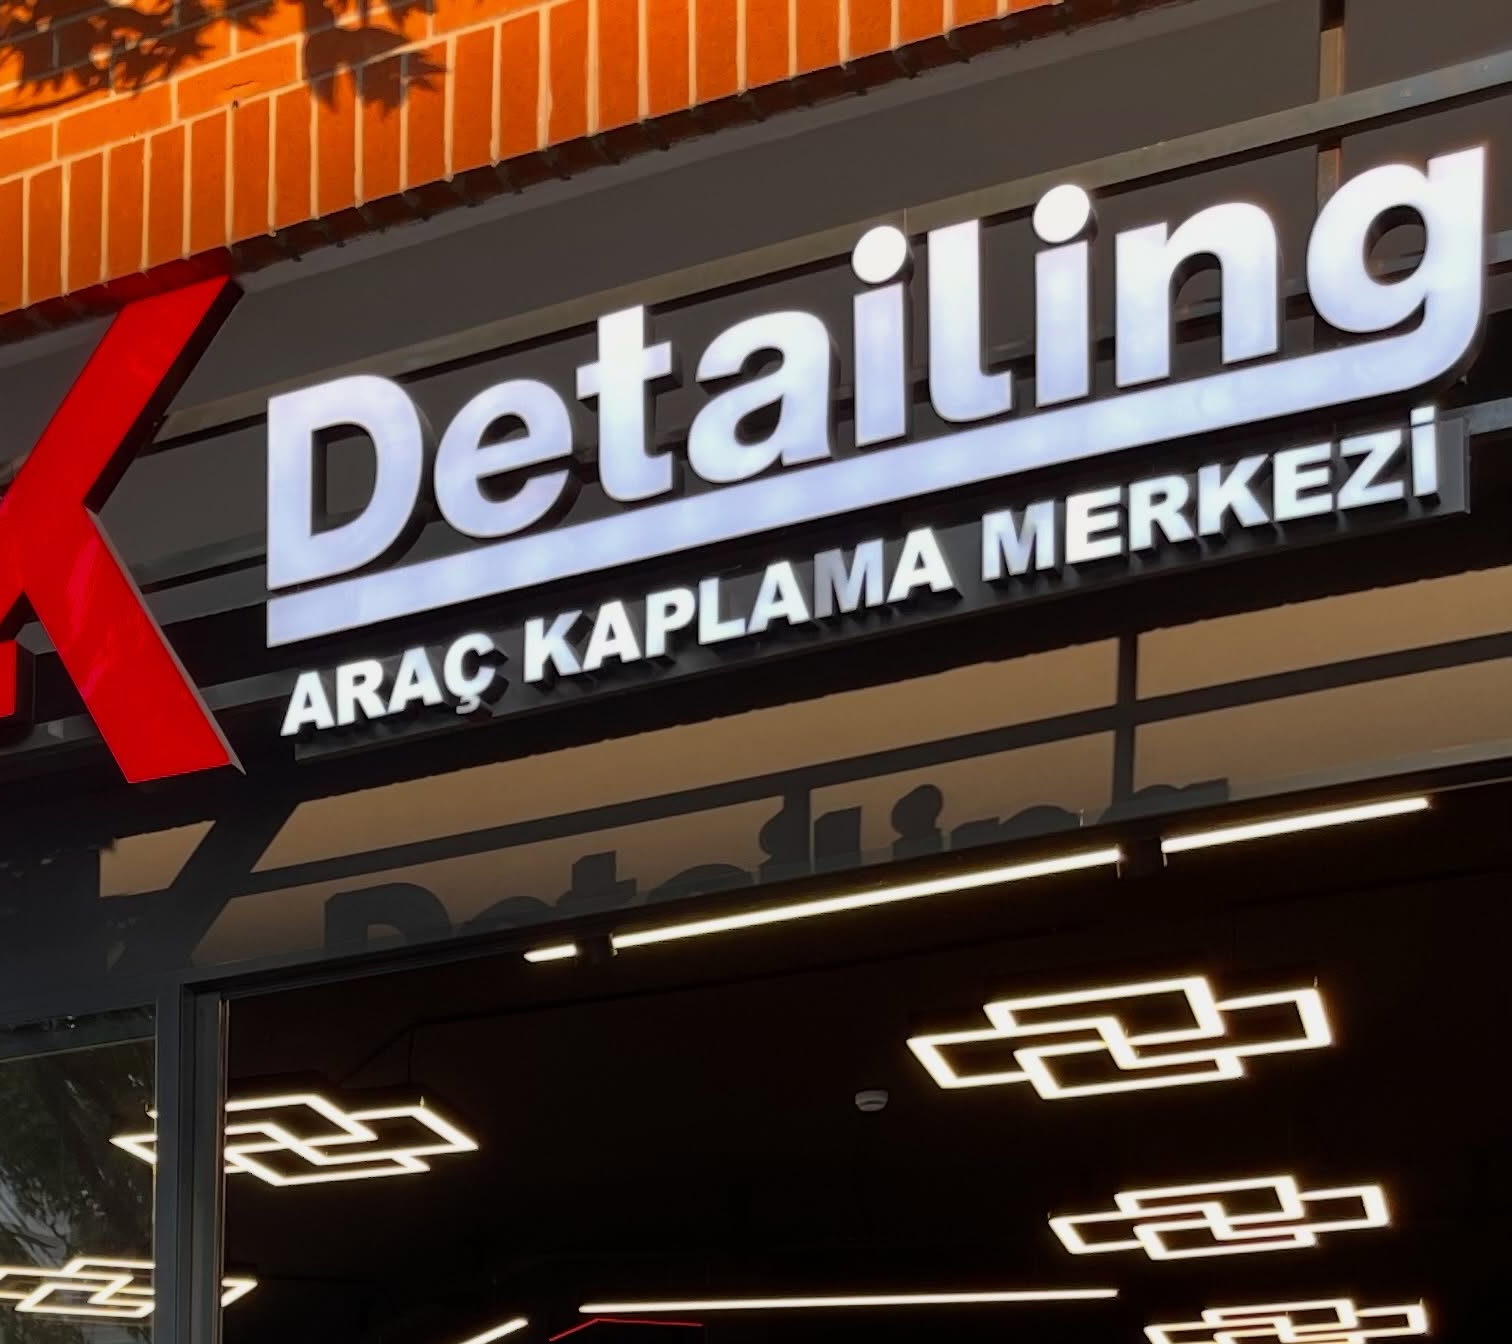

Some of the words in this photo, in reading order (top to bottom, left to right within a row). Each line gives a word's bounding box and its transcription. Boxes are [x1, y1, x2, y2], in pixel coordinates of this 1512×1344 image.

[266, 145, 1487, 594] Detailing
[280, 632, 496, 736] ARAÇ
[523, 526, 955, 684] KAPLAMA
[981, 405, 1438, 582] MERKEZİ
